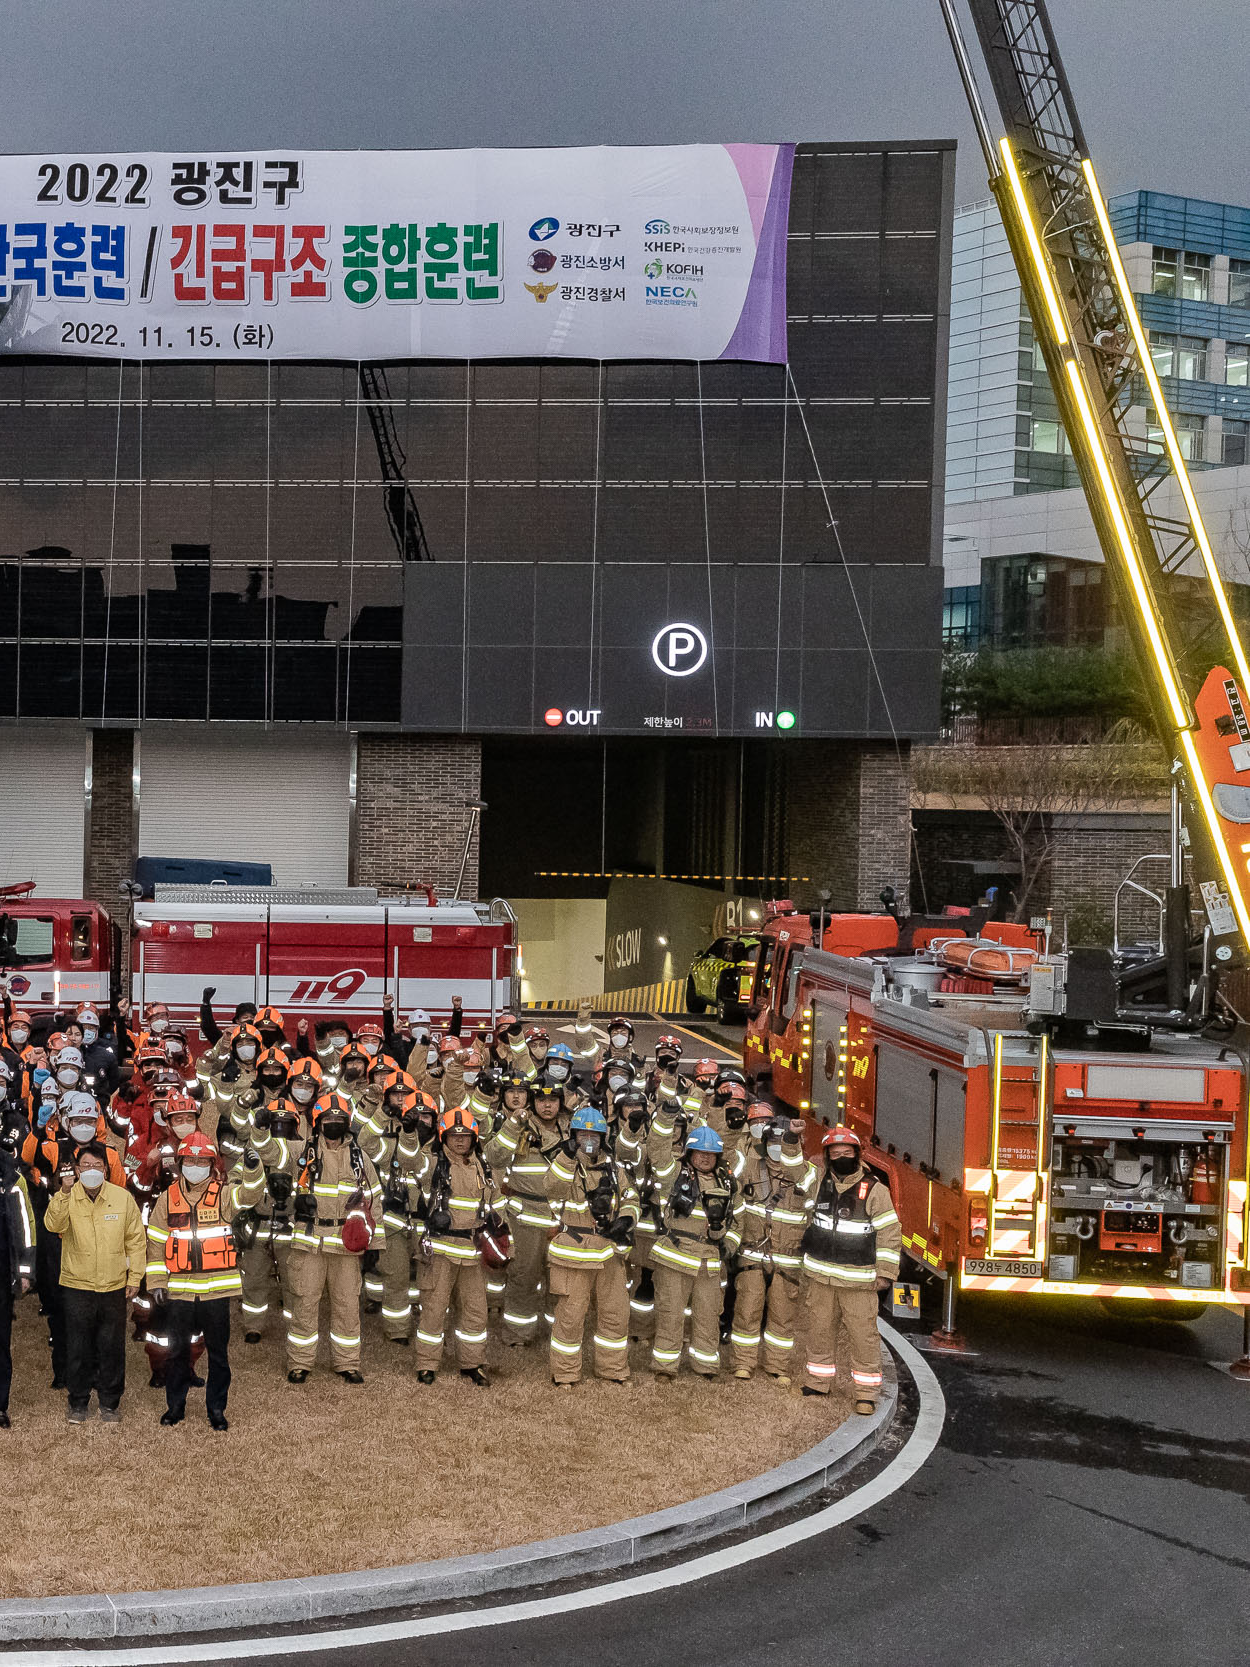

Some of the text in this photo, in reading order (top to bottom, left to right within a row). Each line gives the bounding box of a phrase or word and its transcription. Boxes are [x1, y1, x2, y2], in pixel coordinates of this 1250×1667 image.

[37, 161, 301, 206] 2022 광진구
[566, 223, 621, 238] 광진구
[170, 224, 327, 301] 긴급구조
[342, 222, 500, 304] 종합훈련
[560, 254, 626, 271] 광진소방서
[666, 263, 704, 275] KOFIH
[560, 286, 627, 302] 광진경찰서
[61, 321, 274, 350] 2022. 11. 15. (화)
[565, 709, 602, 726] OUT
[643, 716, 683, 729] 제한높이
[755, 711, 773, 728] IN
[616, 928, 642, 969] SLOW
[287, 968, 368, 1004] 119
[1005, 1262, 1037, 1275] 4850
